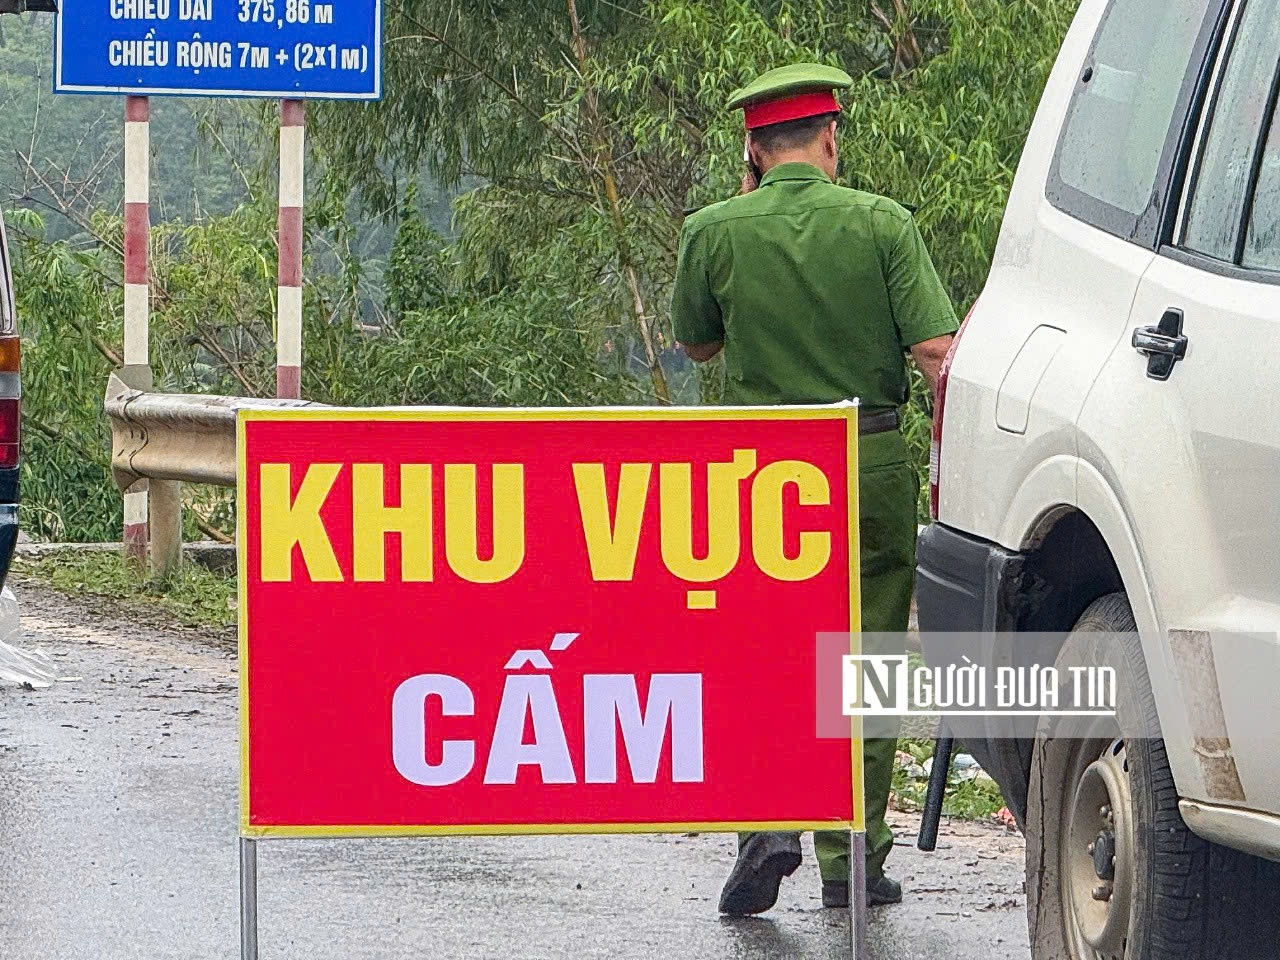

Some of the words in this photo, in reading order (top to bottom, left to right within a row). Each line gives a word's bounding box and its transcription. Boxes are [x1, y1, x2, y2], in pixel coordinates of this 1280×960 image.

[109, 29, 169, 67] CHIỀU
[177, 33, 232, 74] RỘNG
[275, 49, 289, 65] +
[260, 463, 525, 583] KHU
[571, 448, 831, 610] VỰC
[391, 632, 704, 786] CẤM
